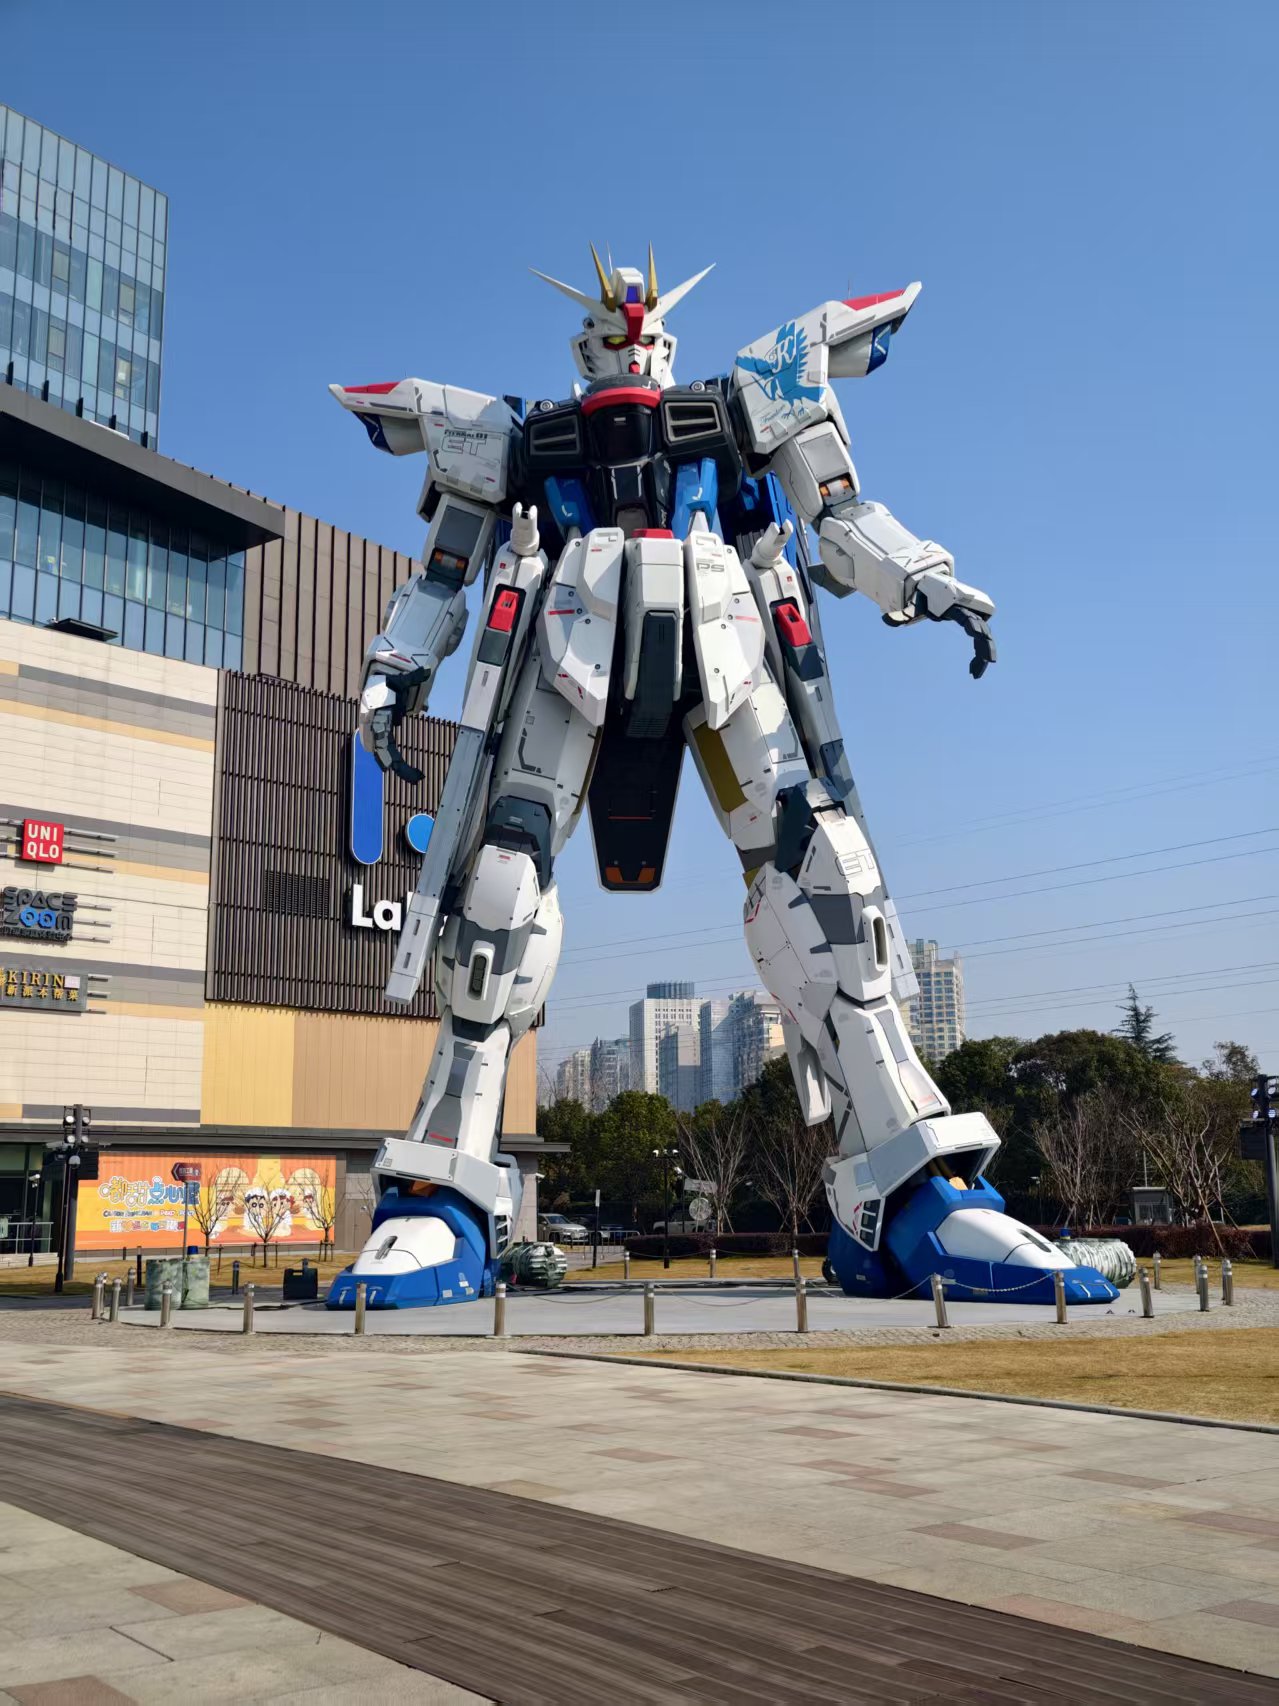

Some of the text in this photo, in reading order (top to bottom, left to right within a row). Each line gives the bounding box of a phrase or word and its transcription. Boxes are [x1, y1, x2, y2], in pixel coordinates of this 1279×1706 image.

[696, 562, 725, 573] PS
[27, 823, 58, 842] UNI
[26, 842, 60, 859] QLO
[3, 886, 78, 912] SPACE
[7, 969, 65, 989] KIRIN
